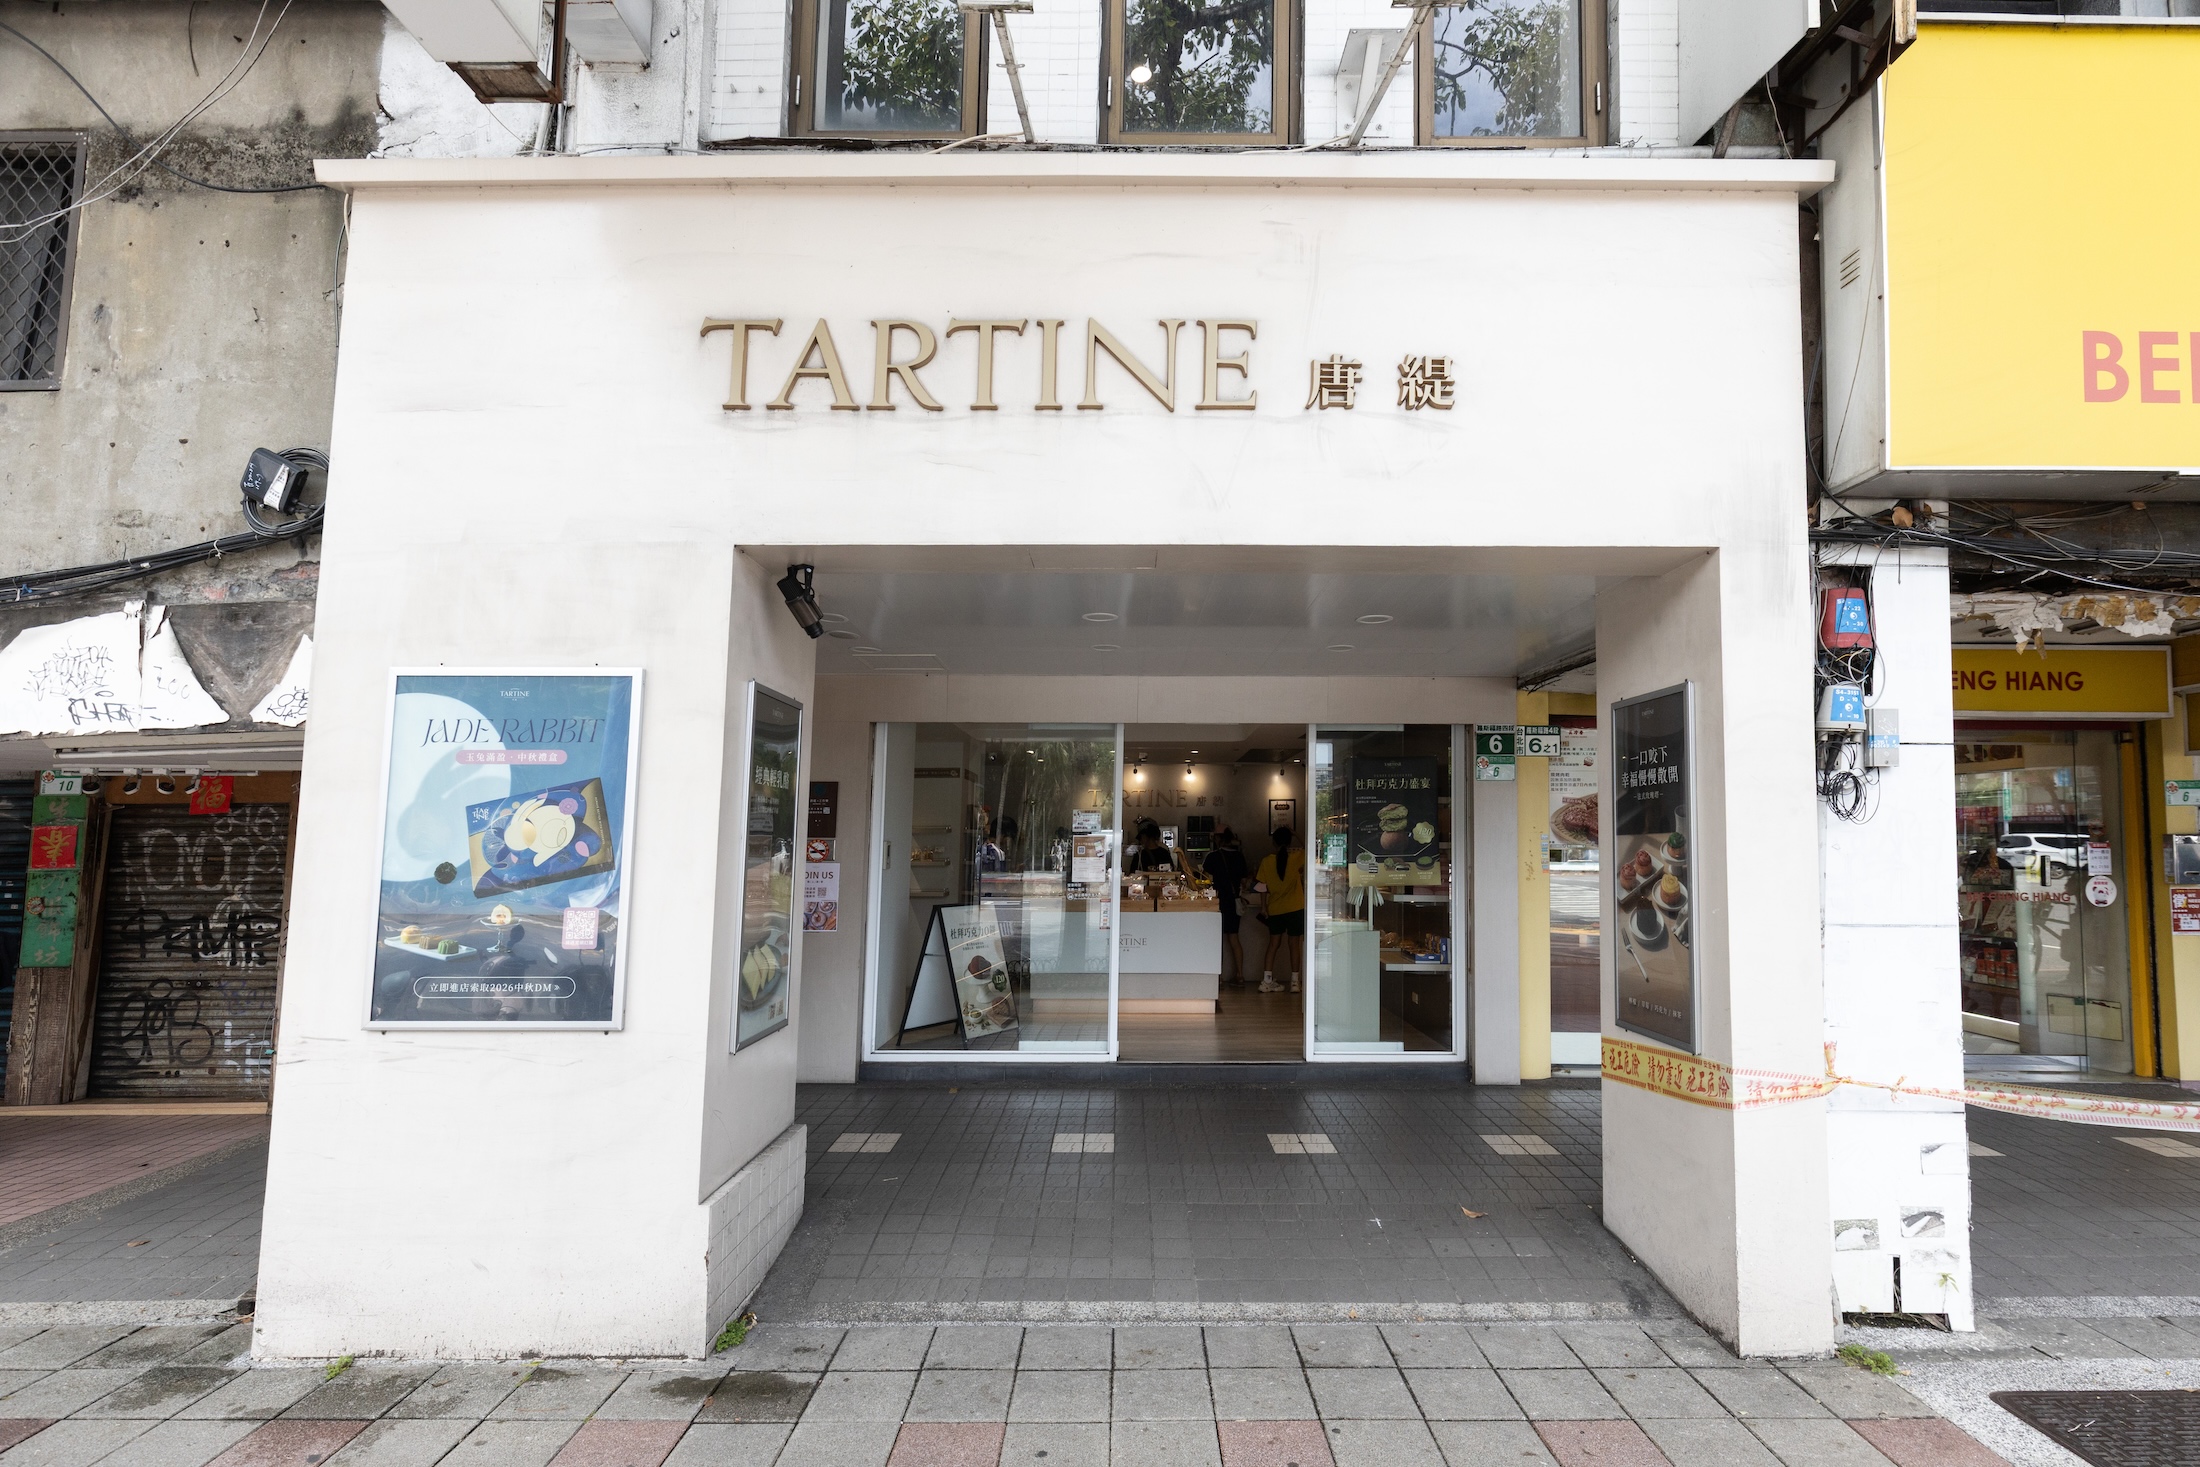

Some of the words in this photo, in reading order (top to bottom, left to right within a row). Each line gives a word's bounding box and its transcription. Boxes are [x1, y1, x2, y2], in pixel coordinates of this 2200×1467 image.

[699, 316, 1259, 413] TARTINE
[2082, 330, 2200, 404] BE
[2006, 671, 2084, 691] HIANG
[421, 718, 494, 748] JADE
[498, 717, 606, 744] RABBIT
[1516, 728, 1524, 755] 台北市
[1488, 734, 1503, 754] 6
[1528, 738, 1558, 754] 6之1
[1630, 745, 1668, 766] 一口咬下
[754, 765, 790, 790] 經典輕乳酪
[1493, 767, 1500, 778] 6
[1621, 765, 1680, 789] 幸福慢慢散開
[59, 780, 74, 792] 10
[196, 777, 227, 810] 福
[1355, 777, 1431, 790] 杜拜巧克力盛宴
[2182, 791, 2190, 802] 6
[38, 829, 73, 863] 春
[821, 871, 834, 880] US
[2032, 892, 2071, 903] HIANG
[1106, 937, 1148, 947] TRTINE
[429, 982, 552, 993] 立即進店索取2026中秋DM
[1647, 1055, 1684, 1090] 請勿靠近
